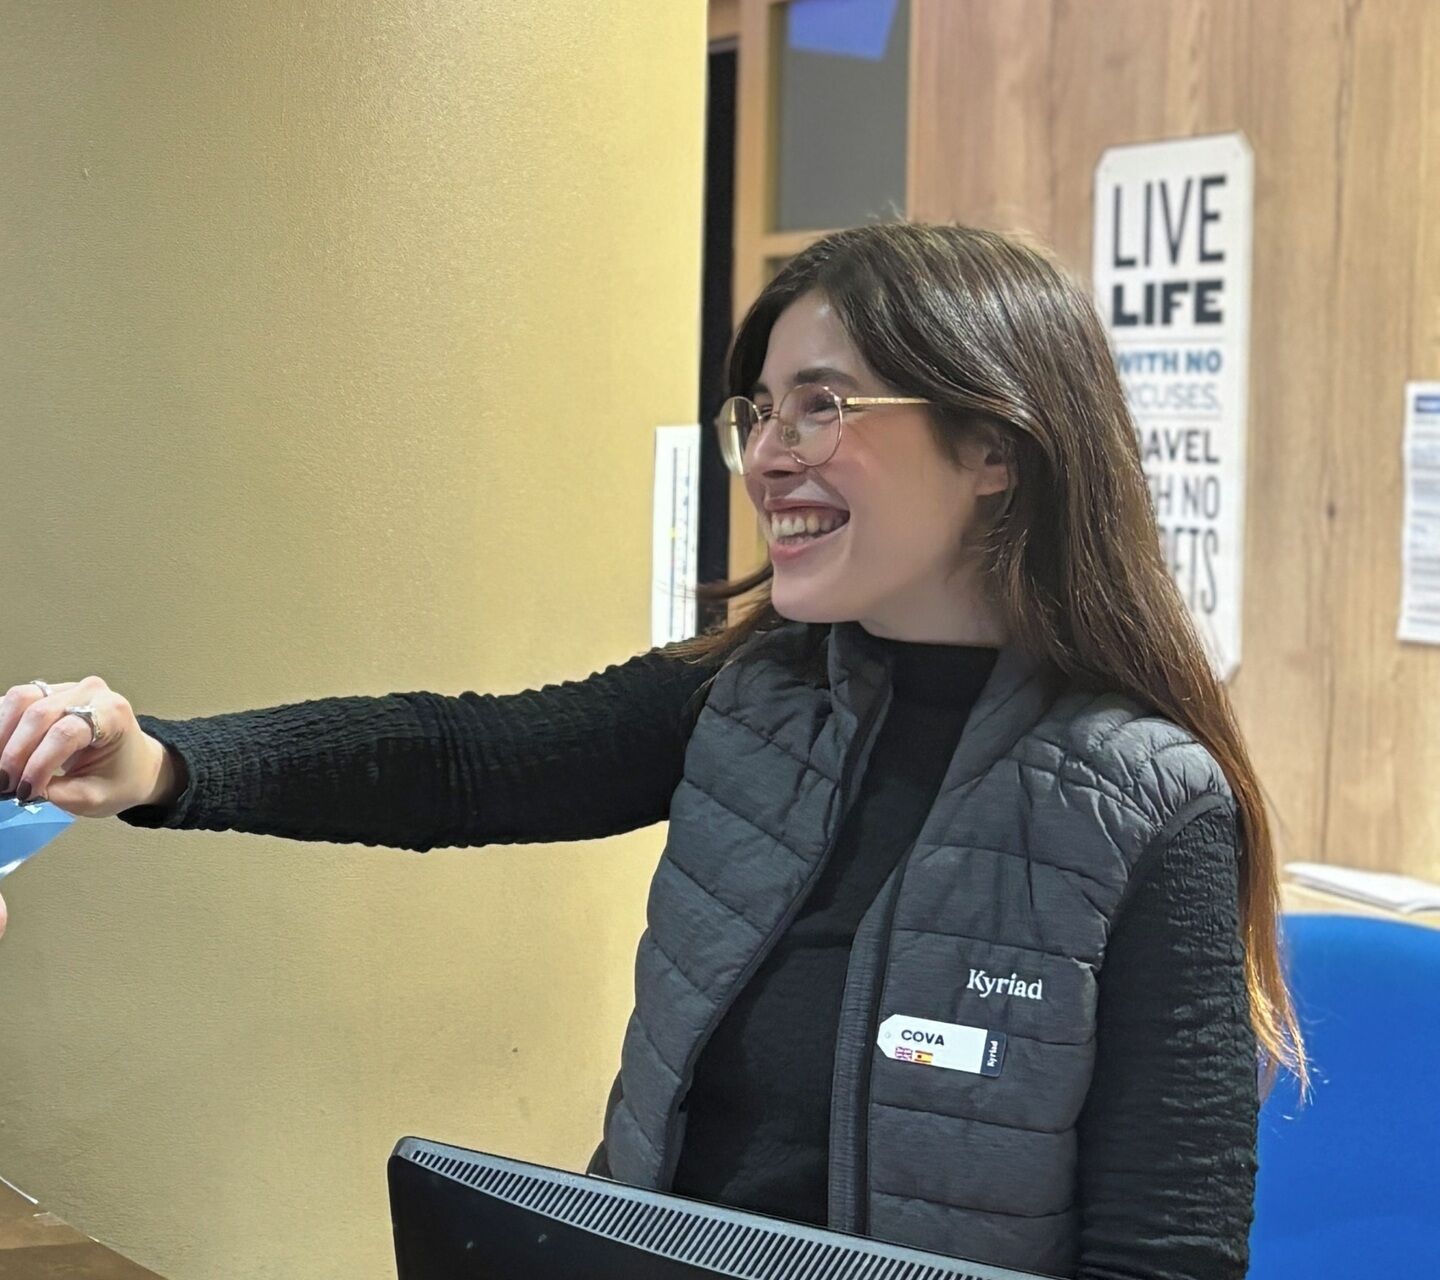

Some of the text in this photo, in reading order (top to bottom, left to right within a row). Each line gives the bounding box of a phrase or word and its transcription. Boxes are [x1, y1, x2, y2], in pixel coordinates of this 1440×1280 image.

[1112, 174, 1227, 269] LIVE
[1111, 279, 1225, 327] LIFE
[1116, 348, 1222, 375] WITH NO
[1181, 475, 1220, 520] NO
[966, 968, 1043, 1000] Kyriad
[901, 1029, 945, 1046] COVA
[986, 1040, 999, 1068] Kyriad
